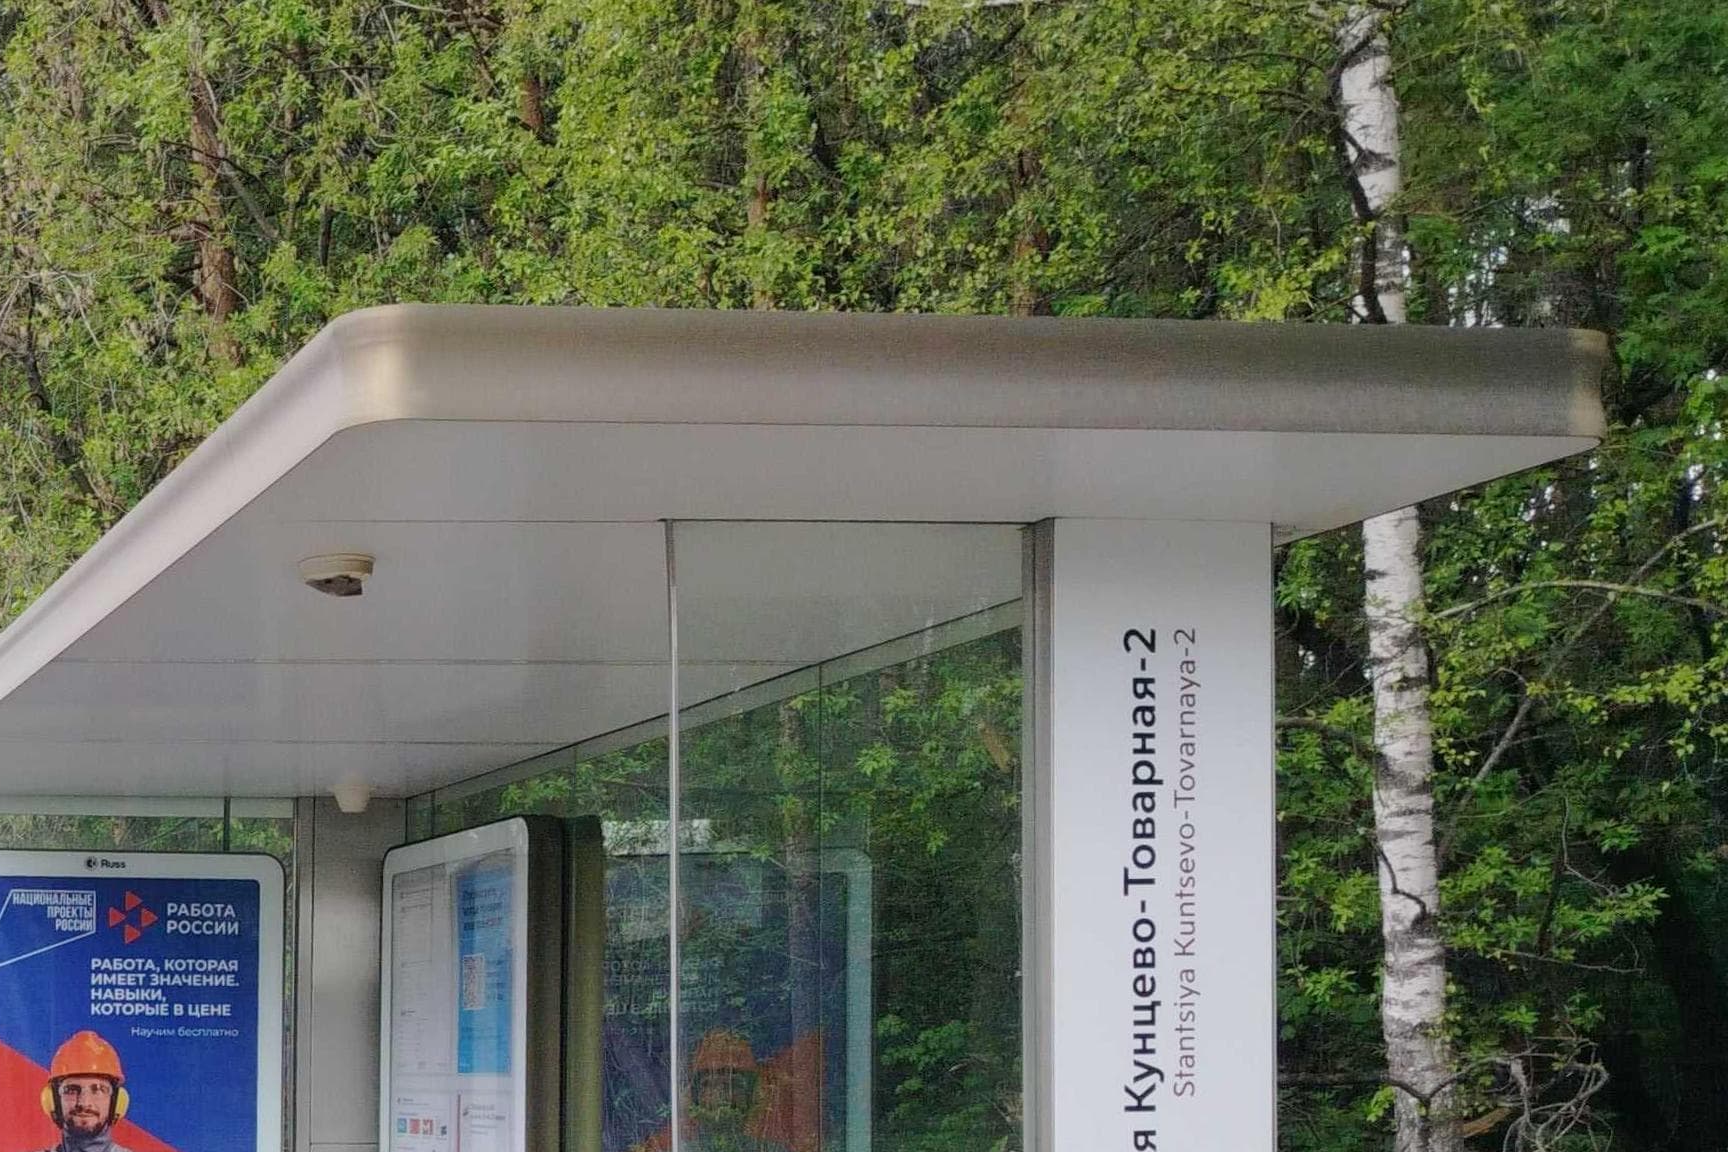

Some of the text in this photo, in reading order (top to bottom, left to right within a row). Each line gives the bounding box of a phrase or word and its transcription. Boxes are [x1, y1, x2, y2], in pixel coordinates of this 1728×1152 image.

[100, 859, 126, 869] Russ
[1172, 627, 1201, 1097] Stantsiya Kuntsevo-Tovarnaya-2
[1123, 628, 1164, 1112] Кунцево-Товарная-2
[12, 892, 93, 906] НАЦИОНАЛЬНЫЕ
[47, 906, 93, 919] ПРОЕКТЫ
[166, 903, 236, 918] РАБОТА
[55, 919, 93, 932] РОССИИ
[166, 920, 239, 935] РОССИИ
[90, 957, 239, 973] РАБОТА, КОТОРАЯ
[90, 973, 240, 987] ИМЕЕТ ЗНАЧЕНИЕ.
[90, 988, 167, 1002] НАВЫКИ,
[90, 1003, 232, 1018] КОТОРЫЕ В ЦЕНЕ
[130, 1025, 239, 1038] Научим бесплатно
